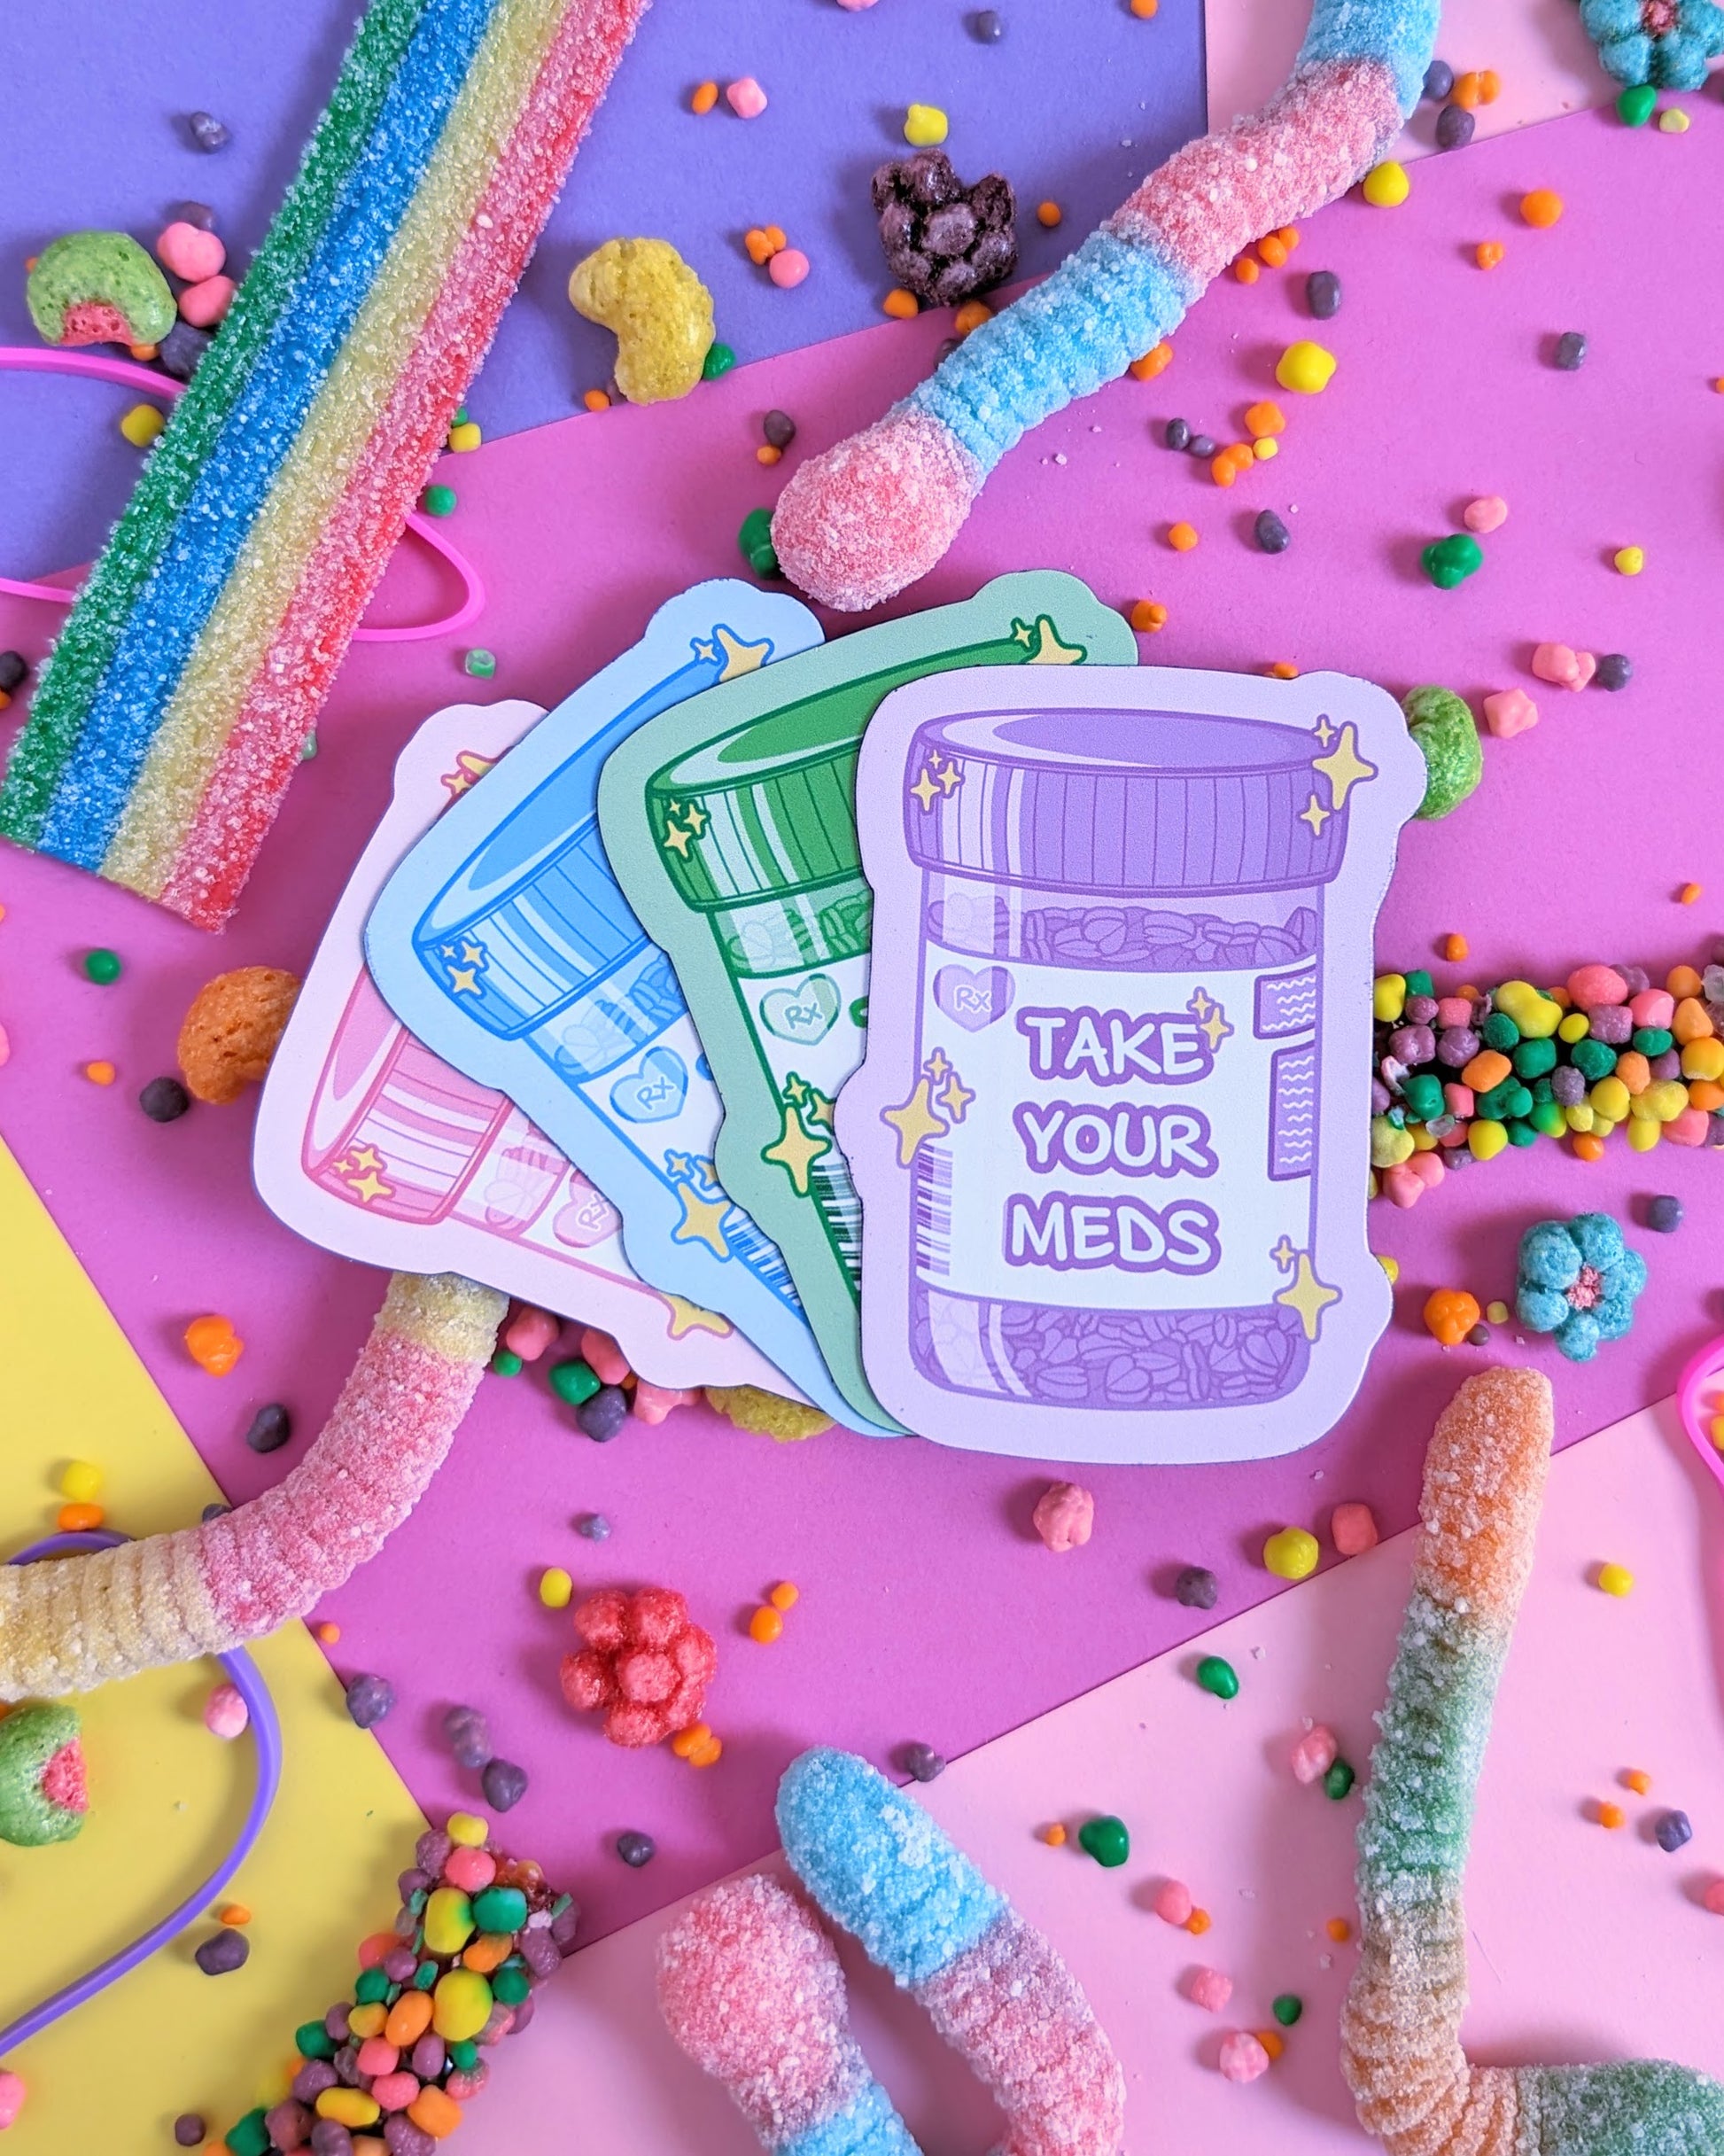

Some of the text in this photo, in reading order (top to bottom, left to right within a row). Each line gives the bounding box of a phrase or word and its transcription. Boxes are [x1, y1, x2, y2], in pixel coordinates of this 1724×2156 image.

[1018, 1008, 1213, 1085] TAKE
[1013, 1102, 1217, 1176] YOUR
[1006, 1193, 1219, 1273] MEDS
